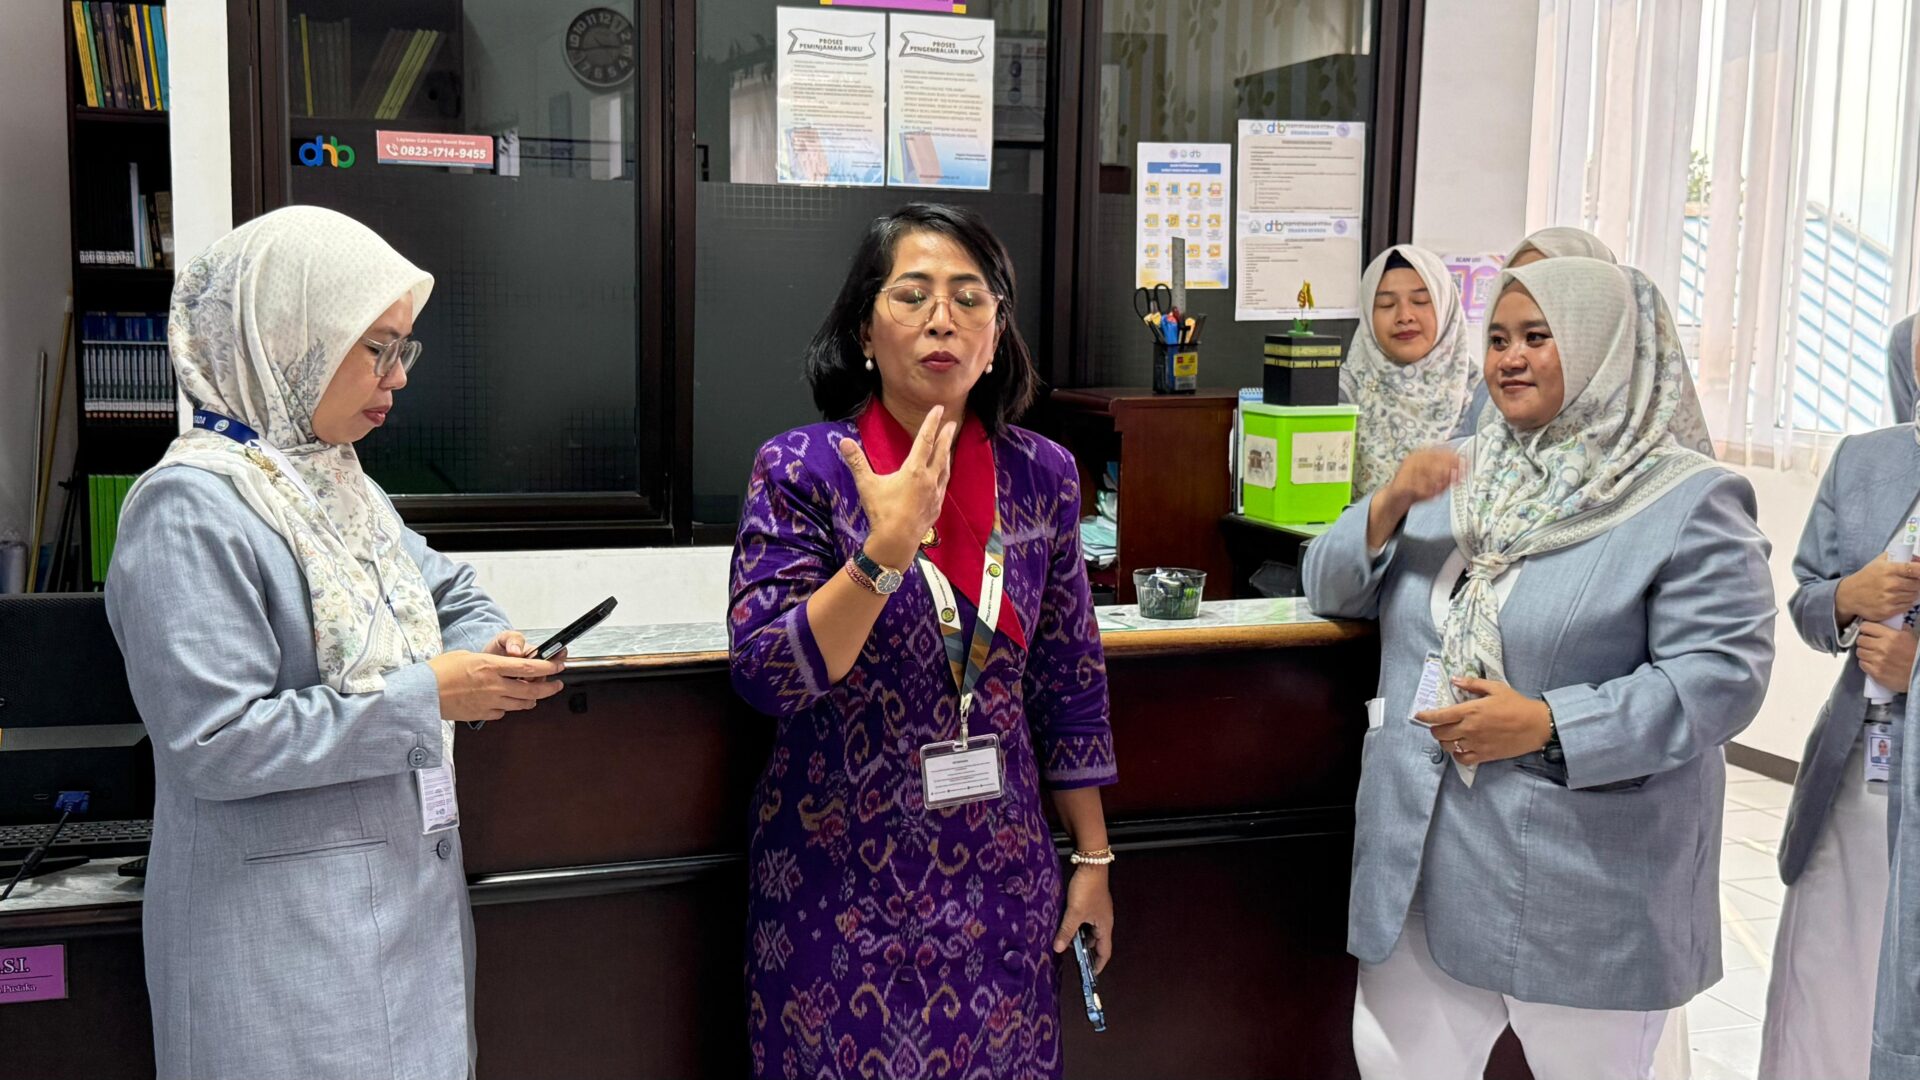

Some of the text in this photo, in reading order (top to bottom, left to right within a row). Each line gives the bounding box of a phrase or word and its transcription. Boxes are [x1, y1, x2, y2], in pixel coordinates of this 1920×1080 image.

[799, 43, 843, 51] PEMINJAMAN
[910, 46, 959, 55] PENGEMBALIAN
[400, 145, 487, 159] 0823-1714-9455
[3, 984, 37, 993] Pustaka
